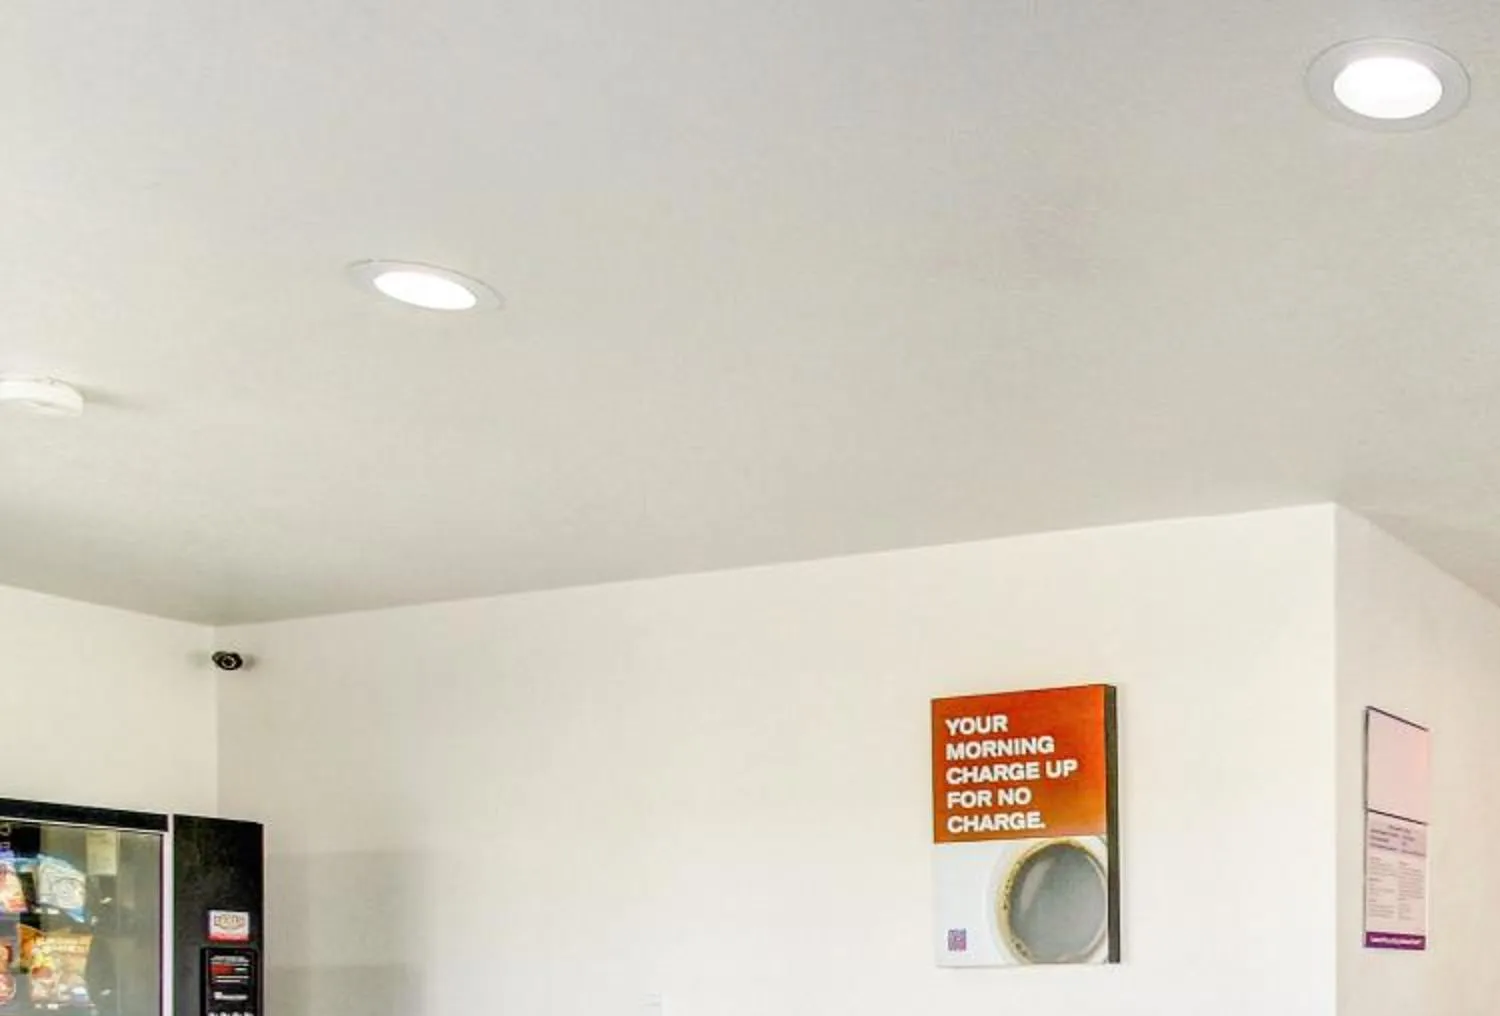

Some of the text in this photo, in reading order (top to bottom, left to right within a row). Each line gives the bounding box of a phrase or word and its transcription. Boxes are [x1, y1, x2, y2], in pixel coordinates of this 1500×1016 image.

[945, 715, 1008, 736] YOUR
[946, 736, 1055, 760] MORNING
[946, 760, 1078, 784] CHARGE UP
[947, 787, 1031, 808] FOR NO
[947, 812, 1046, 833] CHARGE.
